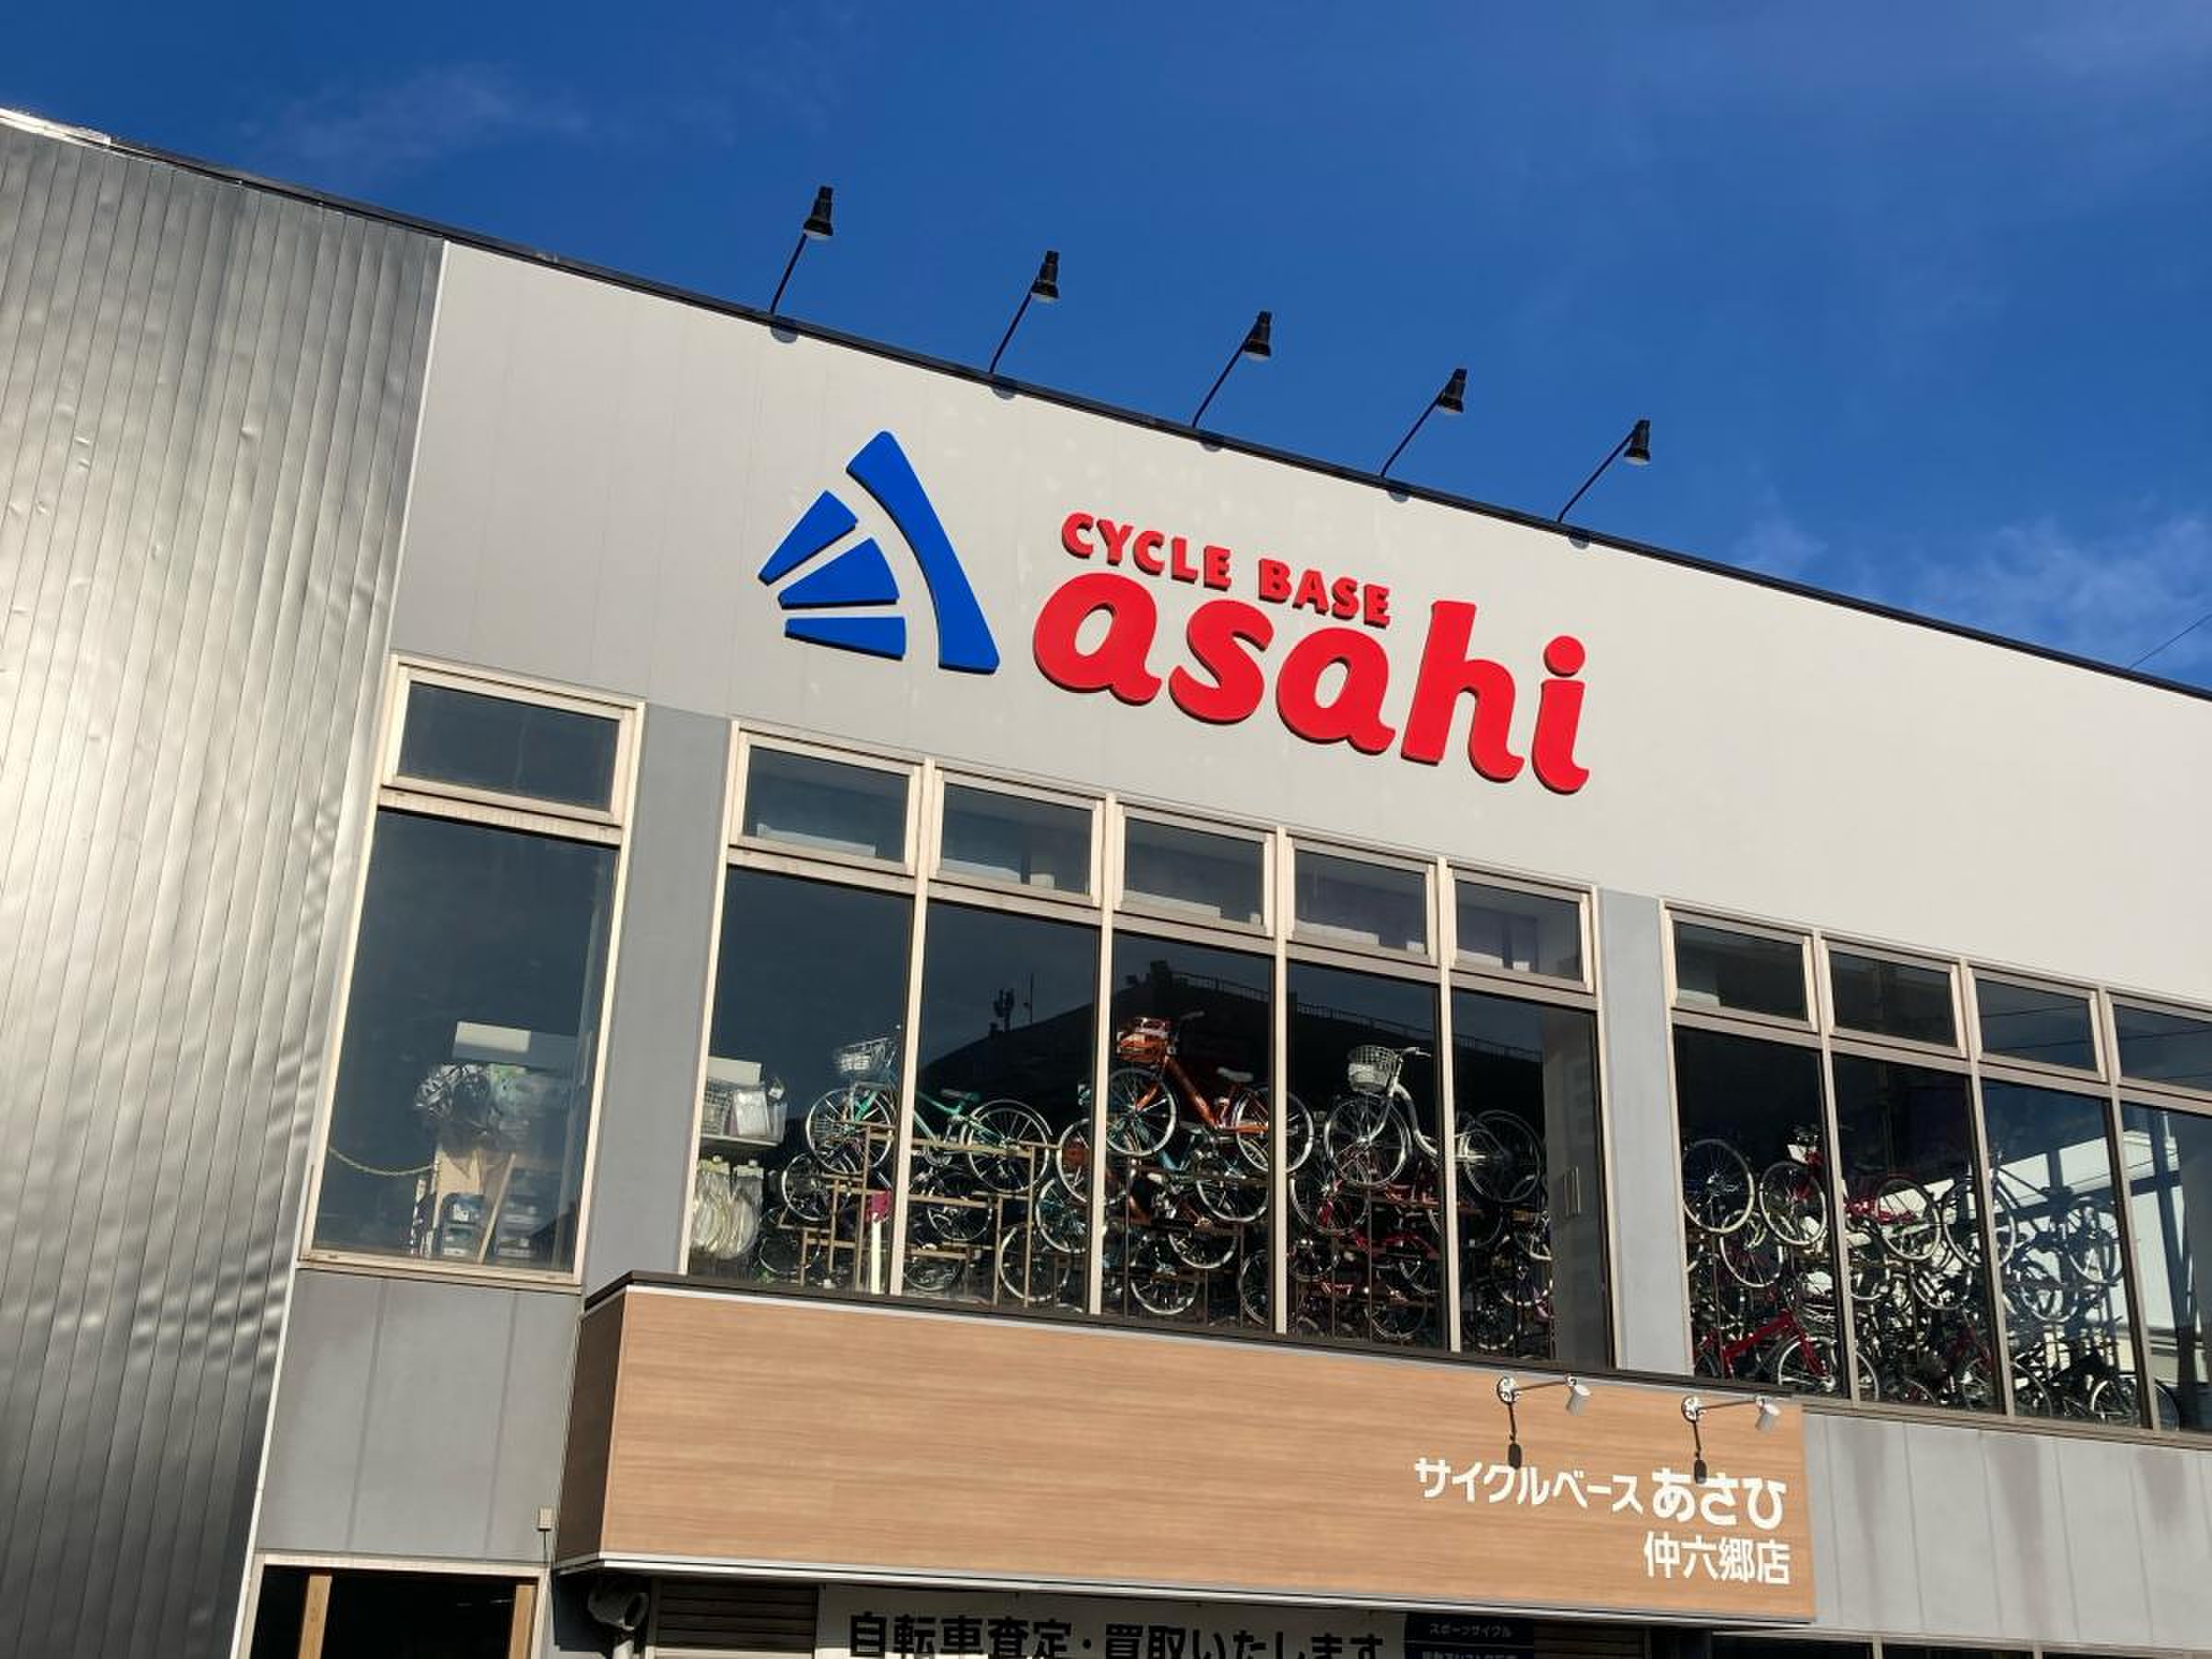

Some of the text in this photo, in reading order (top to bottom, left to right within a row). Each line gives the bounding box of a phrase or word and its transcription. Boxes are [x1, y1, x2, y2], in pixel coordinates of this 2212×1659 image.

[1061, 512, 1392, 628] CYCLE BASE
[1032, 571, 1590, 794] asahi
[1643, 1531, 1791, 1585] 仲六郷店
